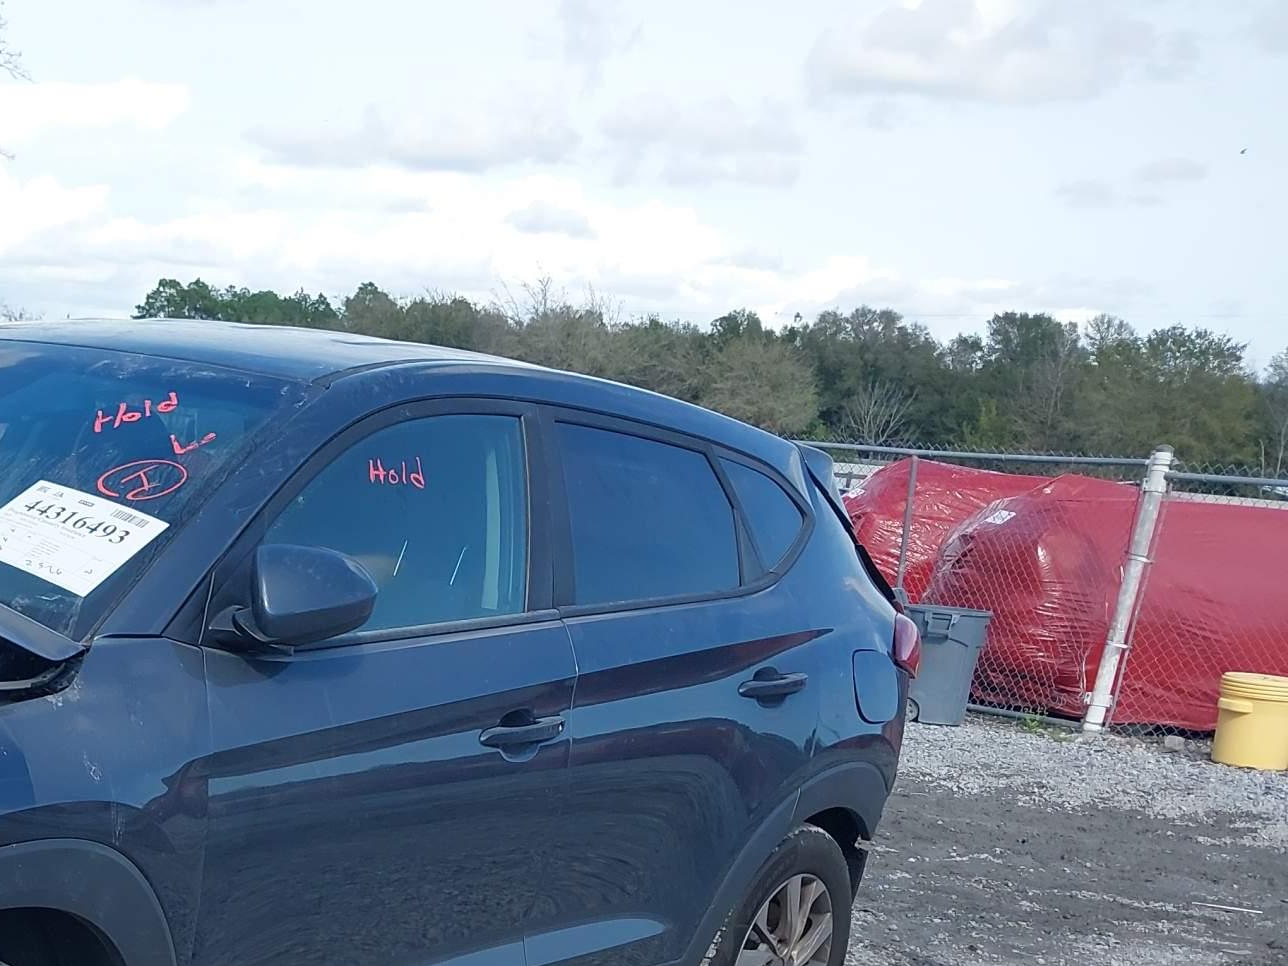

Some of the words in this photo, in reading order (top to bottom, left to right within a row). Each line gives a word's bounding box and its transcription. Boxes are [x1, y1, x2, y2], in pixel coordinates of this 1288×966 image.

[93, 391, 179, 432] Hold
[368, 456, 425, 489] Hold
[23, 499, 130, 544] 44316493
